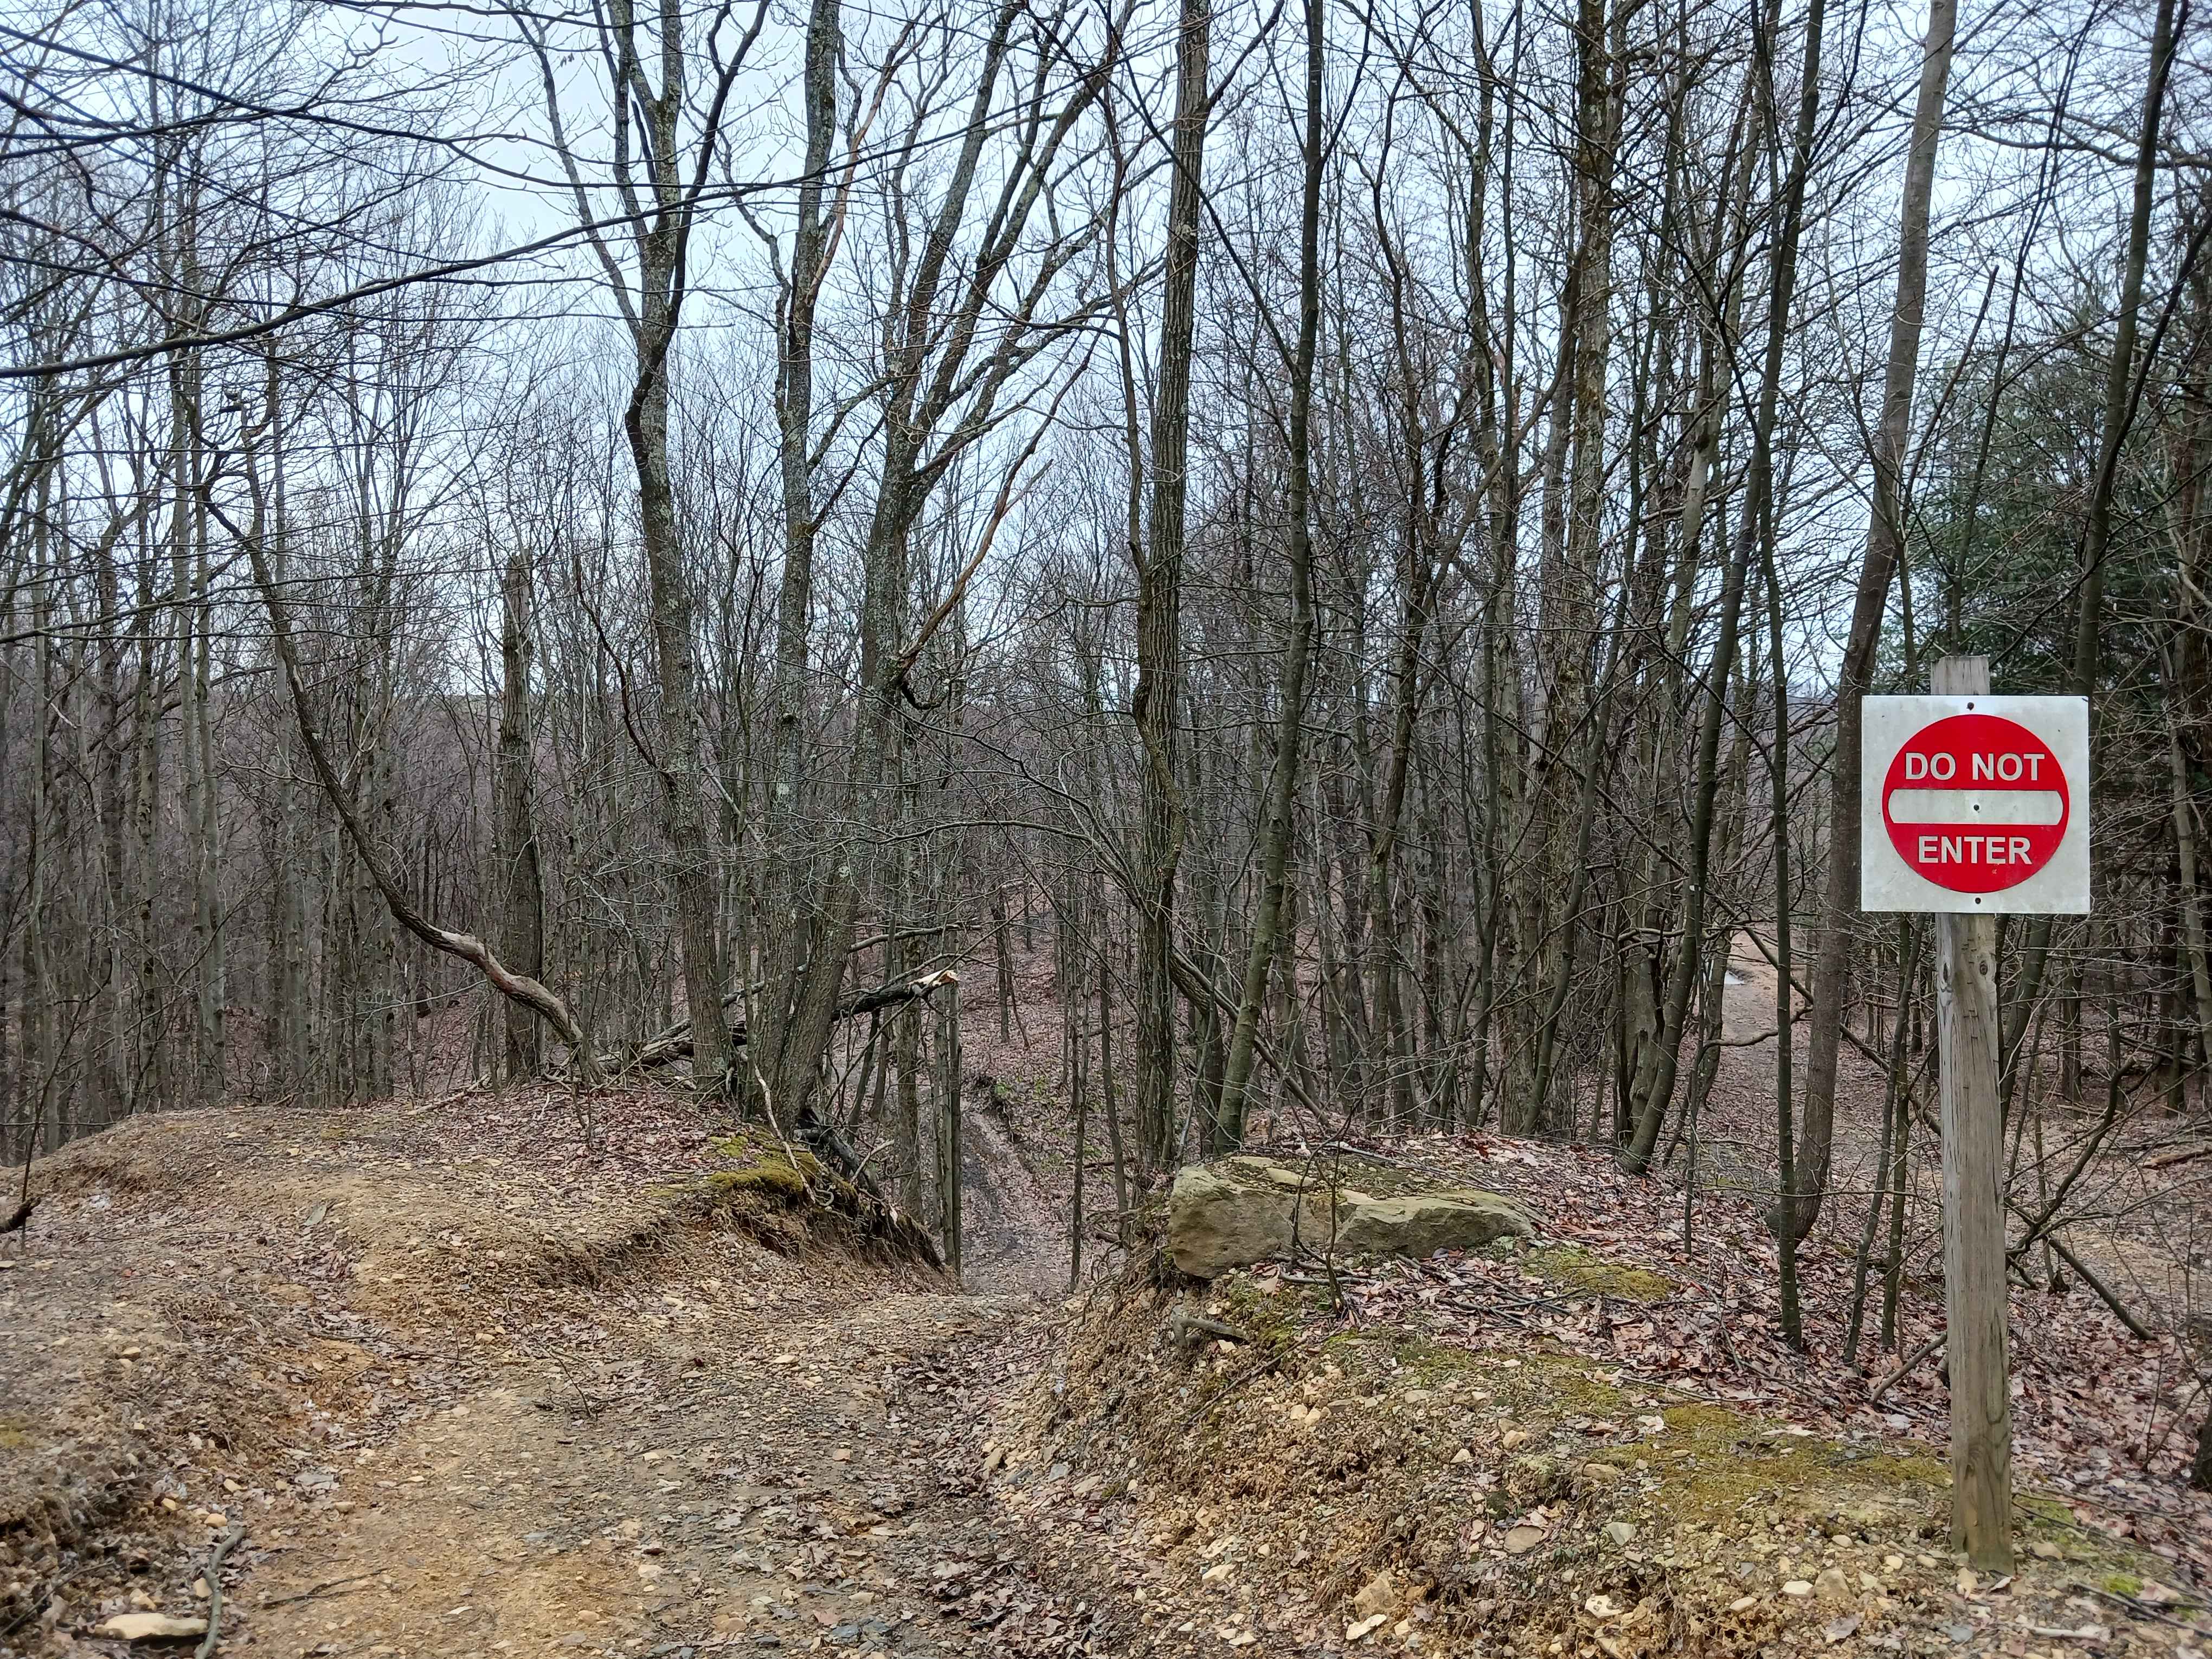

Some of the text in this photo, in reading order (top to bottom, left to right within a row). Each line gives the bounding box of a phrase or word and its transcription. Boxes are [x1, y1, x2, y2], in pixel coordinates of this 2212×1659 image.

[1905, 753, 2045, 781] DO NOT
[1918, 836, 2032, 864] ENTER
